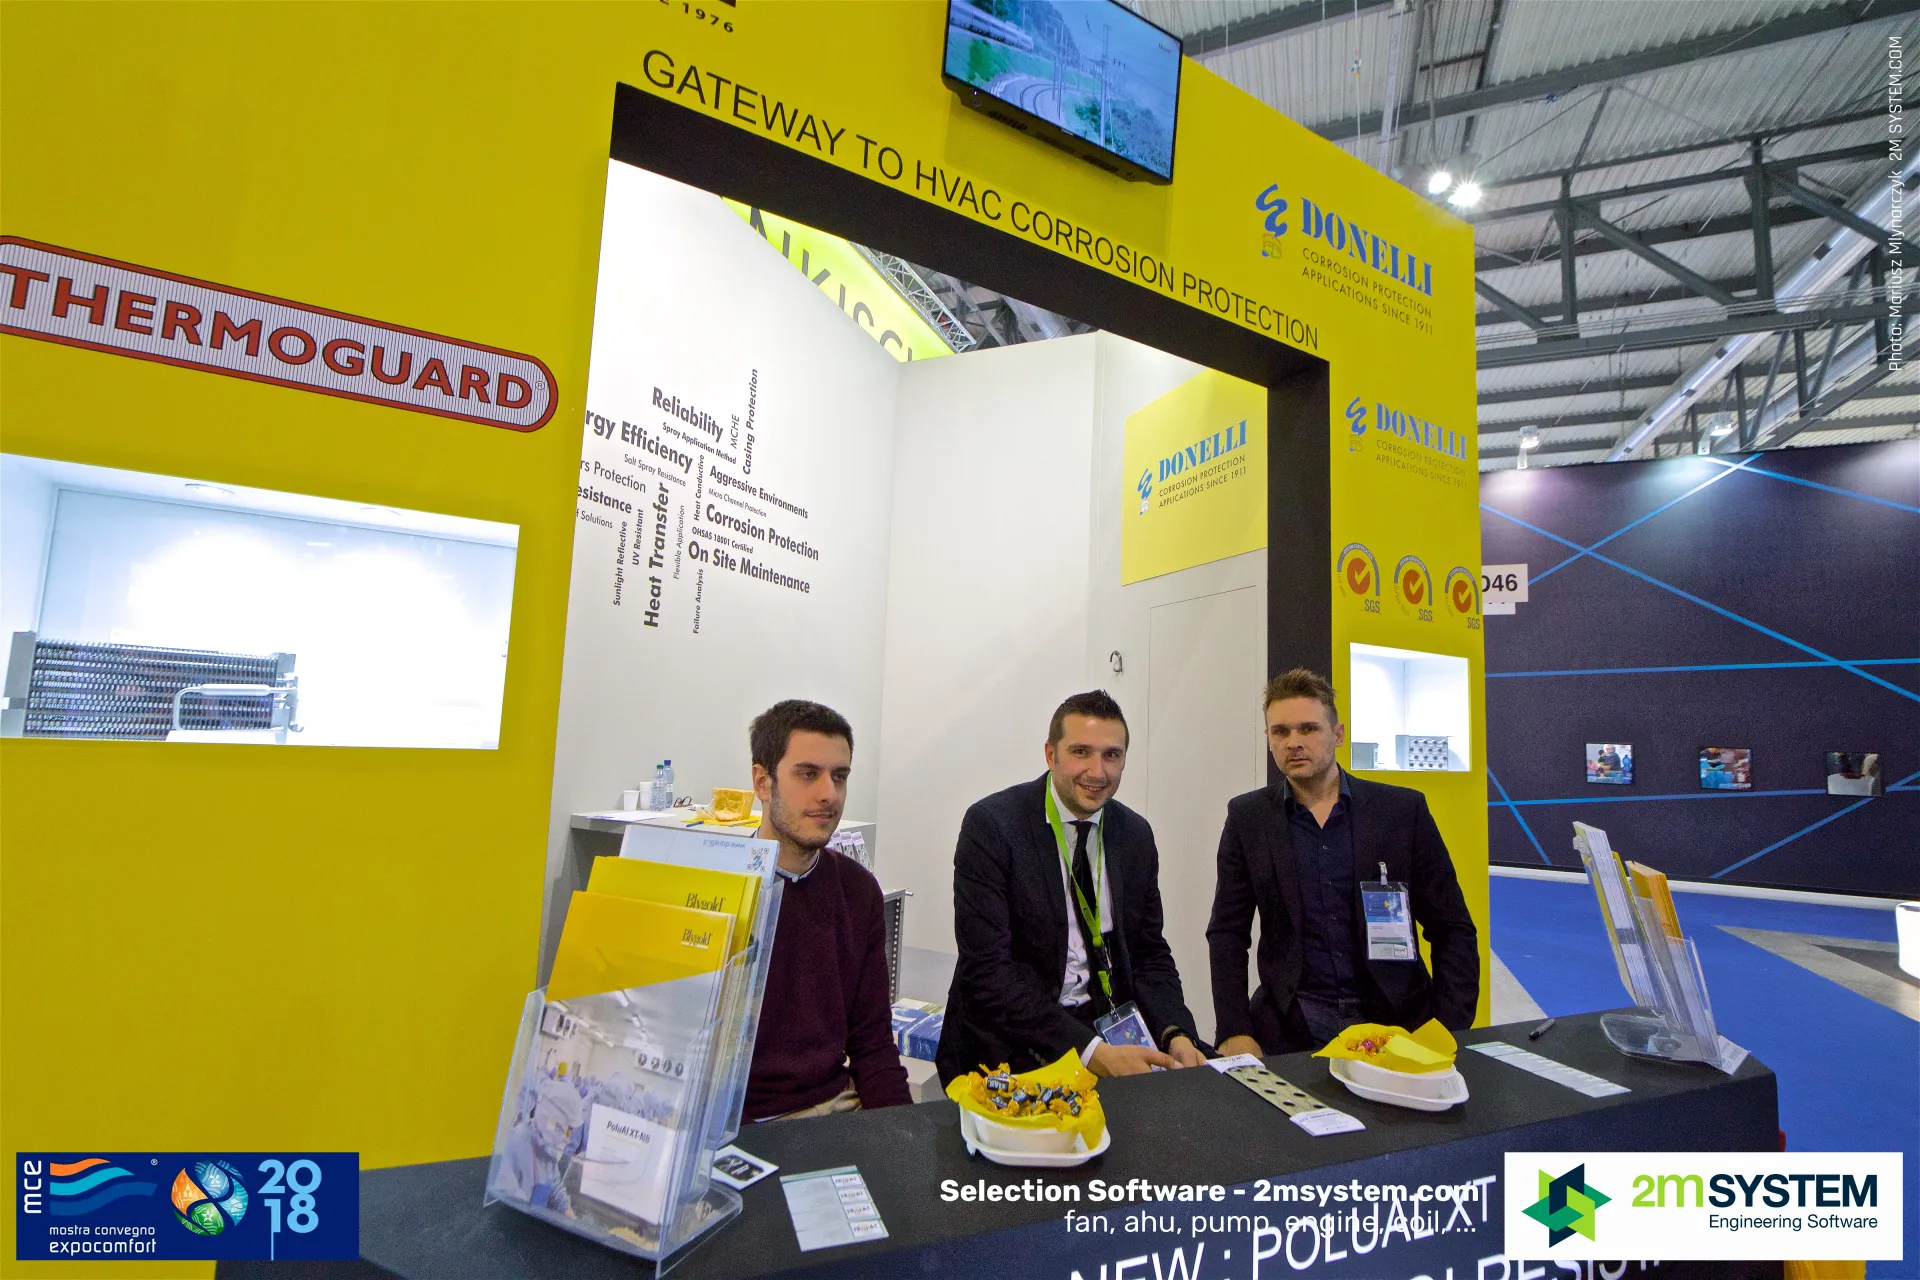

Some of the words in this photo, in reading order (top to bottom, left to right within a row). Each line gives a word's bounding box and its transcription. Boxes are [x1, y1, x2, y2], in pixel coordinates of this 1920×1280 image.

[683, 2, 734, 33] 1976
[643, 50, 846, 155] GATEWAY
[856, 134, 903, 181] TO
[915, 160, 1001, 220] HVAC
[1011, 201, 1174, 292] CORROSION
[1183, 273, 1318, 350] PROTECTION
[1301, 197, 1432, 297] DONELLI
[1302, 248, 1369, 288] CORROSION
[1373, 281, 1432, 317] PROTECTION
[1302, 266, 1378, 310] APPLICATIONS
[1382, 302, 1411, 325] SINCE
[1415, 317, 1433, 336] 1911
[0, 264, 533, 410] THERMOGUARD
[652, 386, 724, 443] Reliability
[746, 368, 758, 431] Protection
[621, 421, 693, 473] Efficiency
[662, 422, 680, 438] Spray
[682, 432, 715, 454] Application
[716, 450, 737, 464] Method
[730, 414, 740, 450] MCHE
[1159, 420, 1247, 483] DONELLI
[1375, 402, 1467, 461] DONELLI
[624, 454, 636, 465] Salt
[638, 459, 656, 475] Spray
[657, 468, 686, 487] Resistance
[742, 433, 755, 475] Casing
[1376, 439, 1422, 461] CORROSION
[1424, 452, 1466, 476] PROTECTION
[1376, 453, 1428, 479] APPLICATIONS
[1430, 470, 1451, 485] SINCE
[1453, 478, 1467, 490] 1911
[594, 461, 646, 493] Protection
[695, 454, 705, 499] Conductive
[710, 466, 757, 497] Aggressive
[759, 487, 808, 519] Environments
[1159, 474, 1198, 497] CORROSION
[1200, 455, 1245, 480] PROTECTION
[1159, 485, 1204, 508] APPLICATIONS
[1206, 473, 1227, 490] SINCE
[1231, 466, 1246, 480] 1911
[581, 511, 613, 528] Solutions
[635, 509, 644, 550] Resistant
[649, 482, 669, 567] Transfer
[692, 526, 712, 540] OHSAS
[714, 533, 730, 546] 18001
[731, 540, 754, 554] Certified
[706, 504, 765, 541] Corrosion
[768, 528, 819, 561] Protection
[617, 521, 627, 565] Reflective
[632, 552, 640, 565] UV
[673, 550, 682, 580] Flexible
[688, 541, 708, 563] On
[712, 548, 736, 571] Site
[740, 557, 810, 593] Maintenance
[695, 568, 703, 603] Analysis
[613, 567, 623, 606] Sunlight
[643, 578, 662, 627] Heat
[1364, 599, 1380, 613] SGS
[1418, 608, 1433, 622] SGS
[1467, 617, 1480, 630] SGS
[686, 893, 724, 912] Blygold
[682, 929, 711, 945] Blygold
[1070, 1242, 1205, 1280] EW
